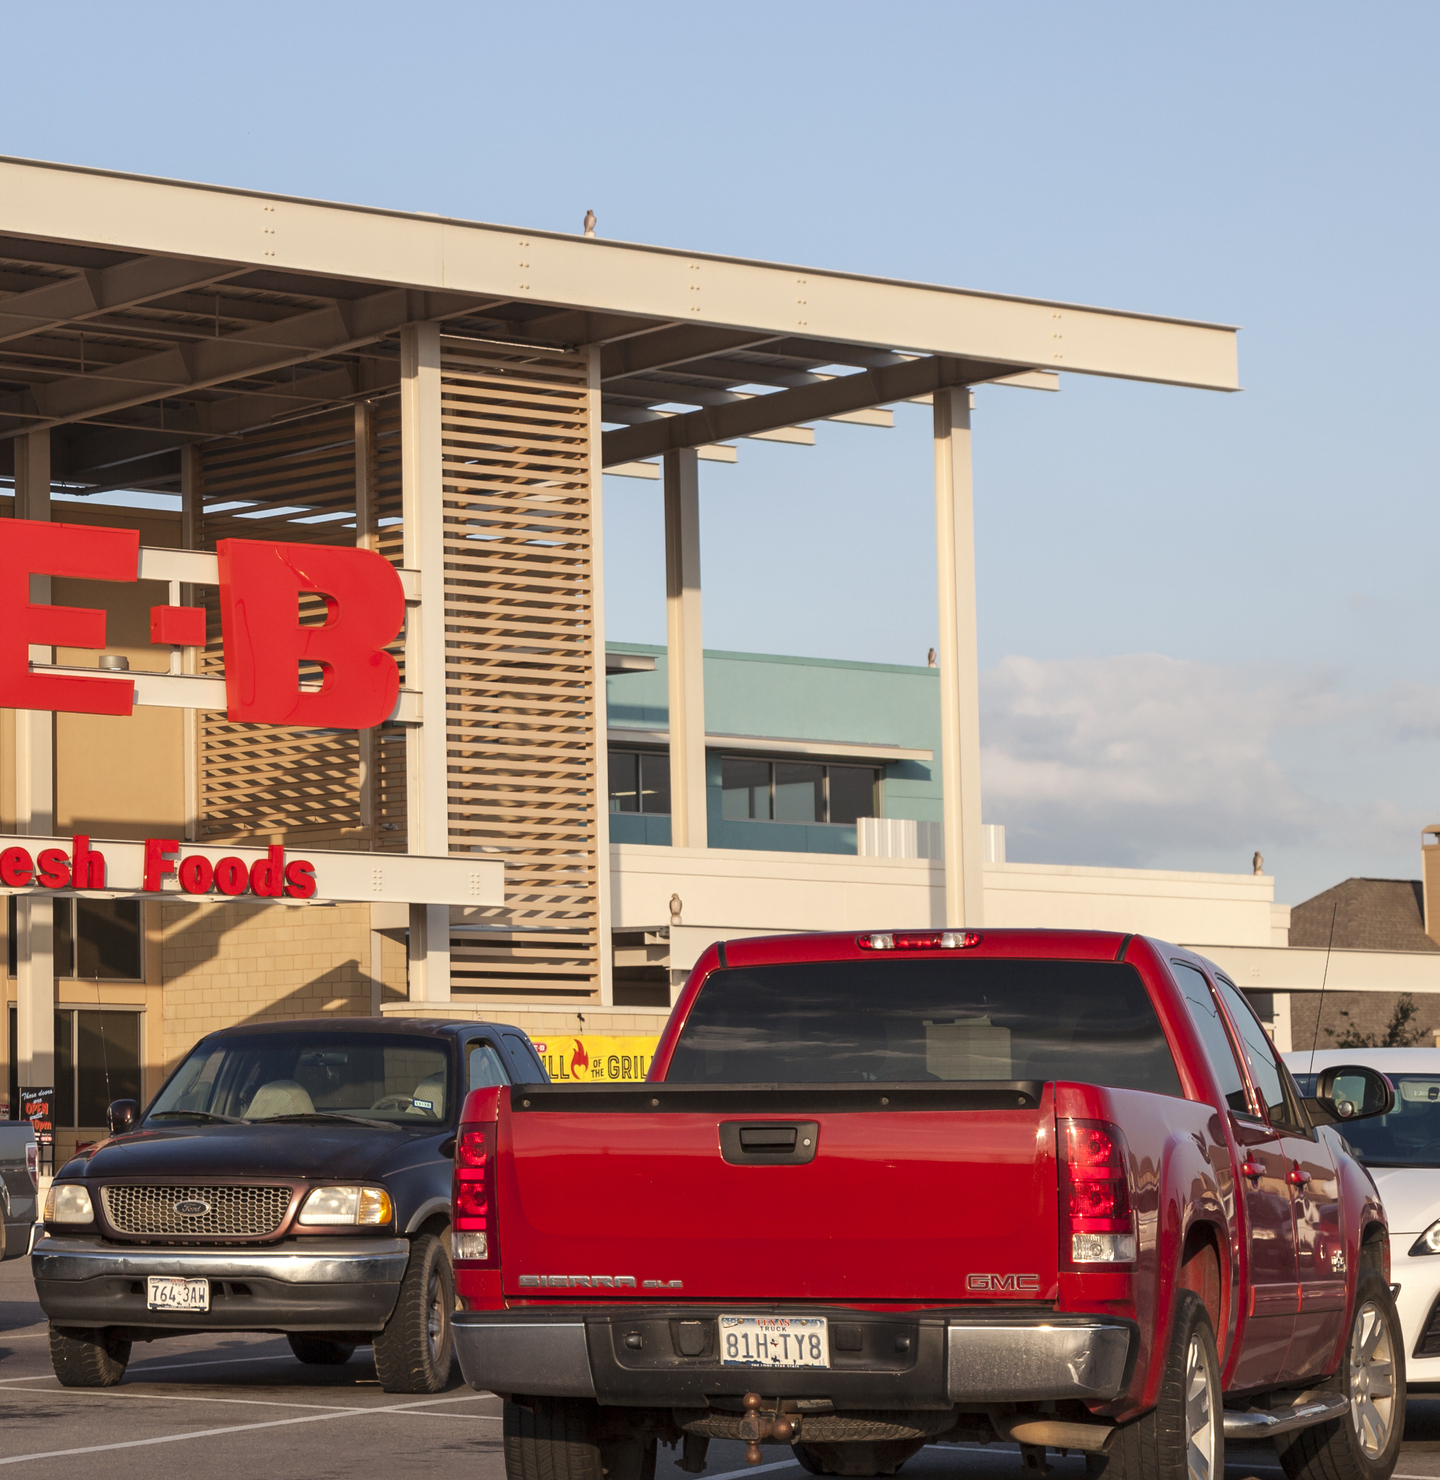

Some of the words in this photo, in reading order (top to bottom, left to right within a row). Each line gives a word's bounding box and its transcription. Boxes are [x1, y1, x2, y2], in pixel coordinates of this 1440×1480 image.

[143, 838, 317, 899] Foods
[593, 1059, 602, 1068] OF
[607, 1055, 654, 1079] GRIL
[591, 1068, 604, 1078] THE
[25, 1102, 49, 1115] OPEN
[181, 1204, 201, 1213] Ford
[518, 1275, 636, 1288] SIERRA
[642, 1280, 683, 1288] SLE
[966, 1273, 1039, 1291] GMC
[755, 1318, 791, 1326] TEXAS
